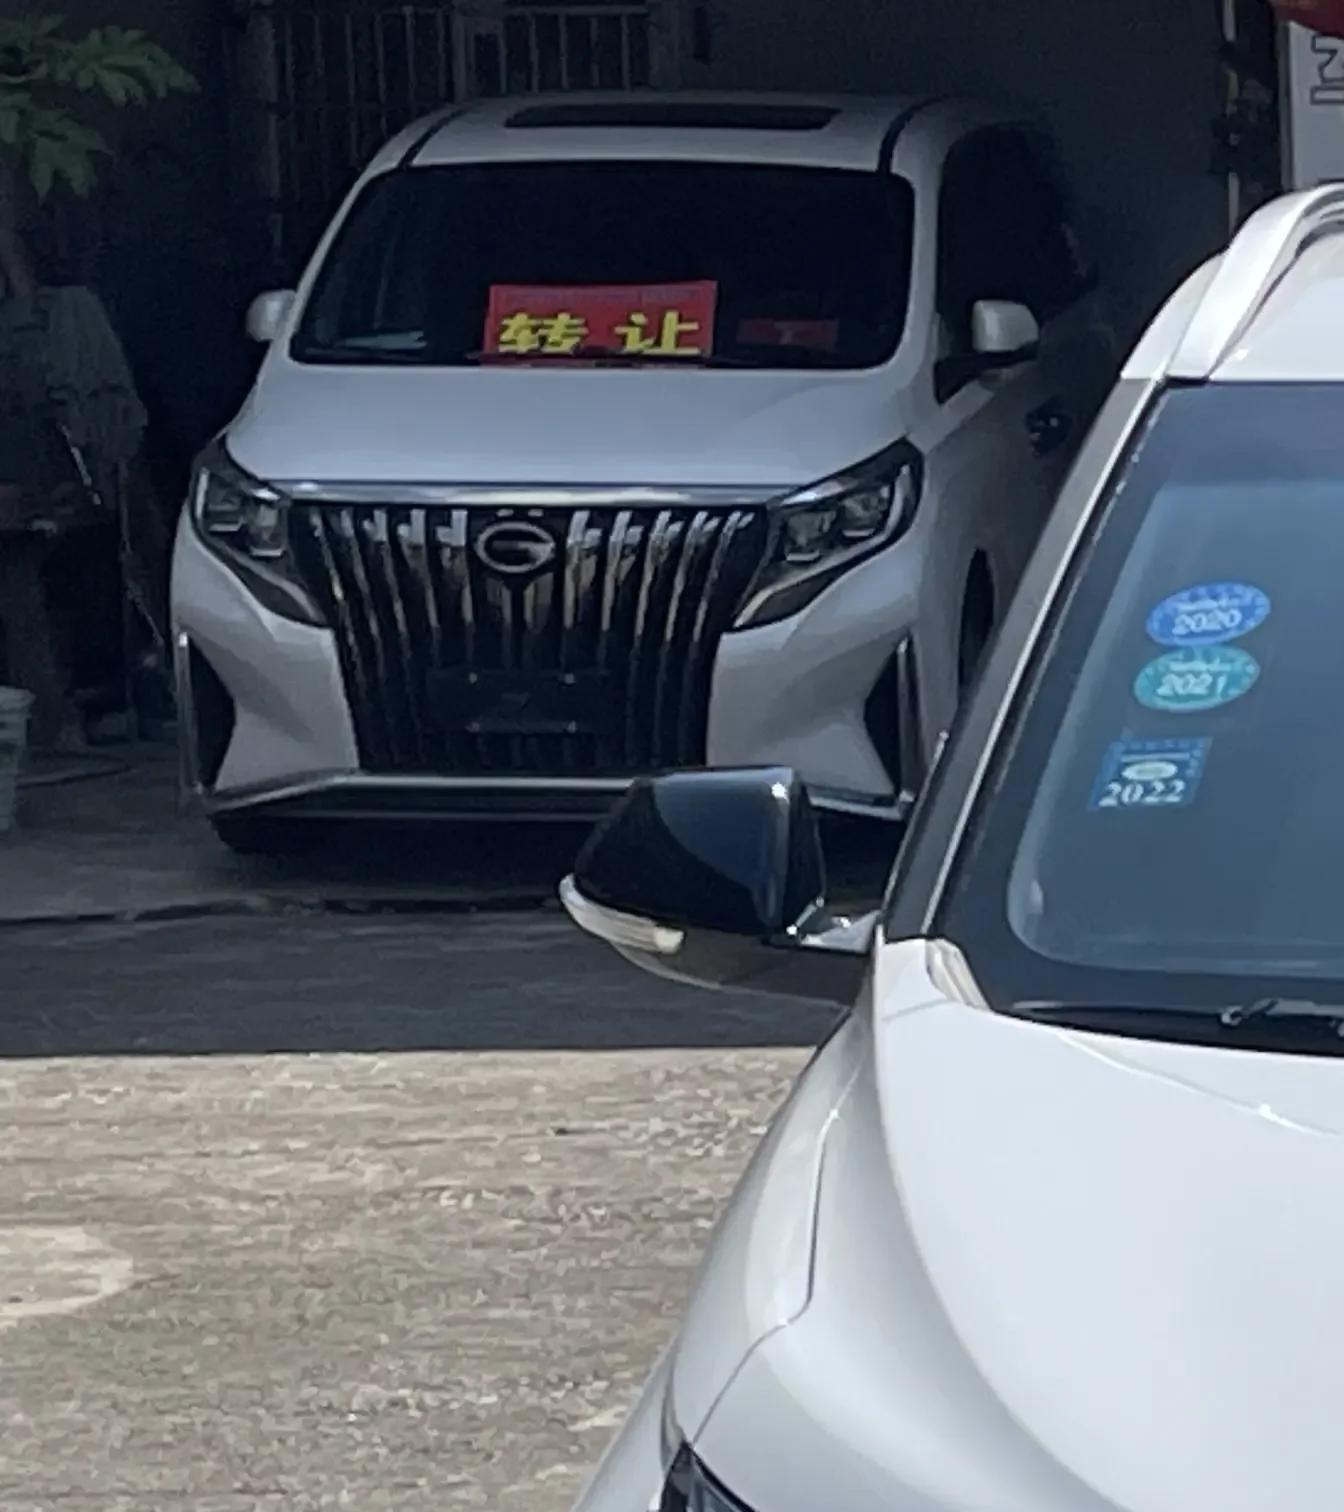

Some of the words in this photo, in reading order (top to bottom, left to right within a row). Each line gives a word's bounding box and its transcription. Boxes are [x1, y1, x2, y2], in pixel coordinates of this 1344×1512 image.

[498, 310, 702, 356] 转让
[1173, 610, 1241, 635] 2020
[1157, 673, 1227, 696] 2021
[1098, 780, 1185, 807] 2022
